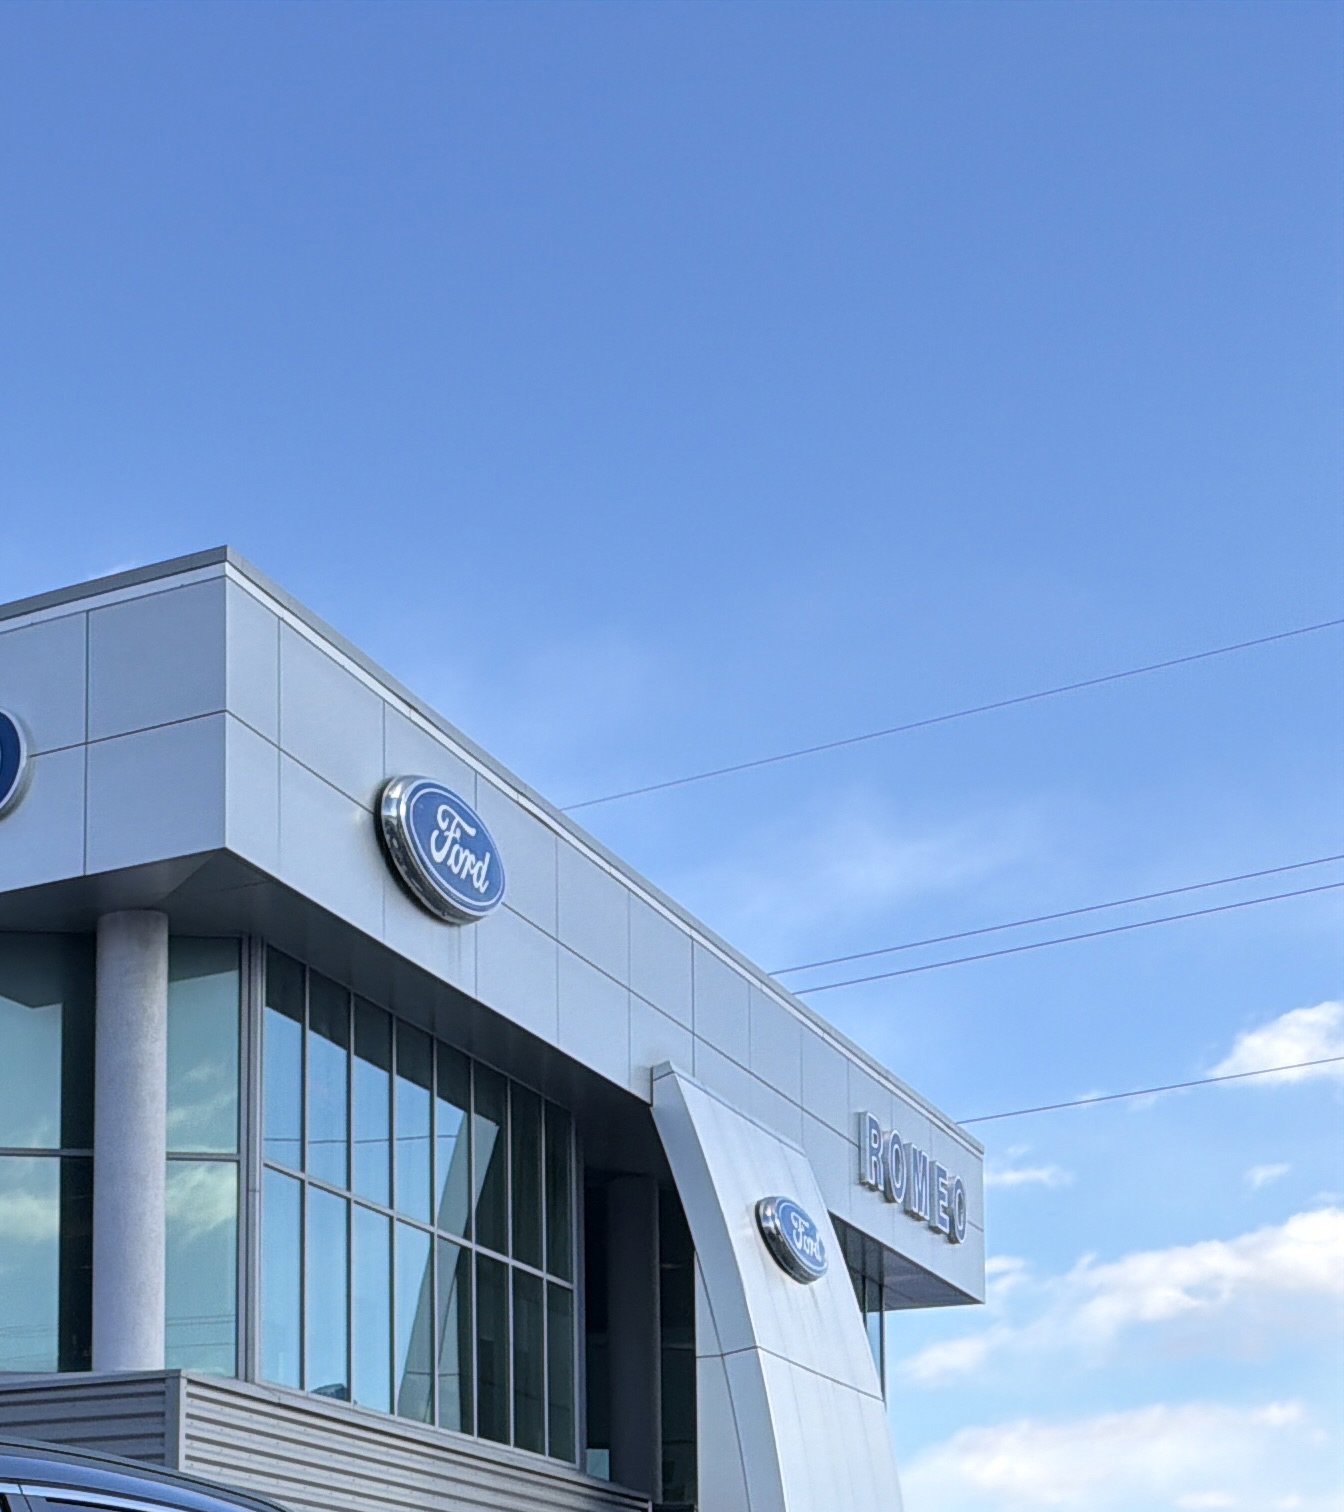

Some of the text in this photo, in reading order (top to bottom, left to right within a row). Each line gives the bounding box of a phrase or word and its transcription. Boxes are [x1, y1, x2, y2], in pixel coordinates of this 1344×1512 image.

[429, 803, 492, 895] Ford
[862, 1111, 967, 1244] ROMEO
[790, 1211, 824, 1263] Ford
